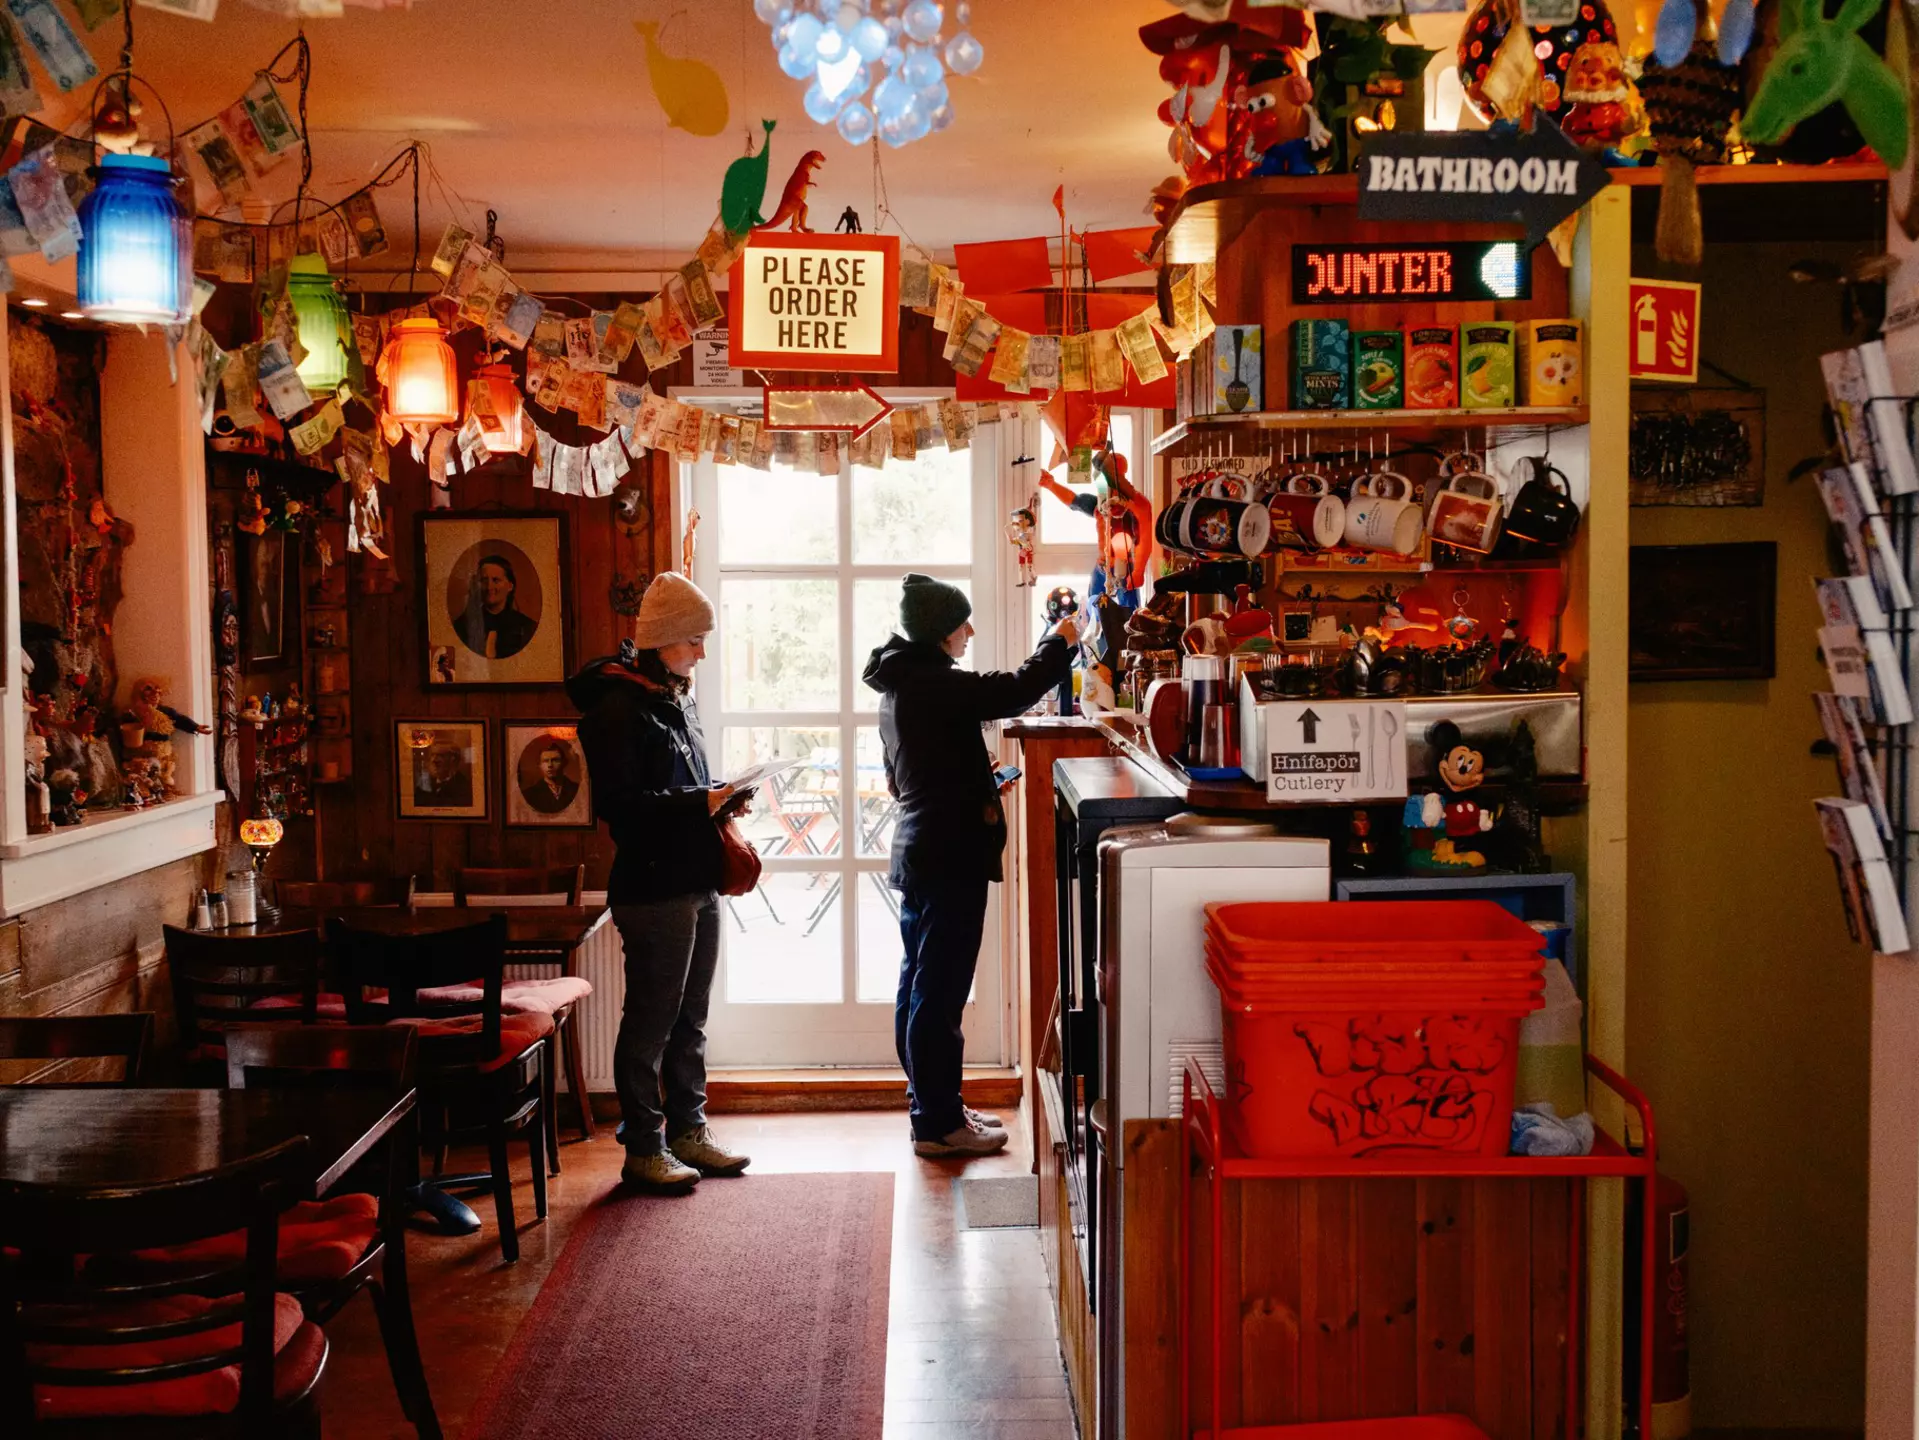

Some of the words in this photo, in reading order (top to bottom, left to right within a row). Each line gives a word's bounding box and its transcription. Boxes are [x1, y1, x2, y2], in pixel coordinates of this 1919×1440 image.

[1366, 155, 1580, 195] BATHROOM
[762, 256, 866, 287] PLEASE
[768, 287, 858, 317] ORDER
[778, 320, 847, 349] HERE
[1306, 380, 1339, 389] MINTS
[1273, 755, 1358, 772] Hnífapör
[1274, 776, 1346, 793] Cutlery
